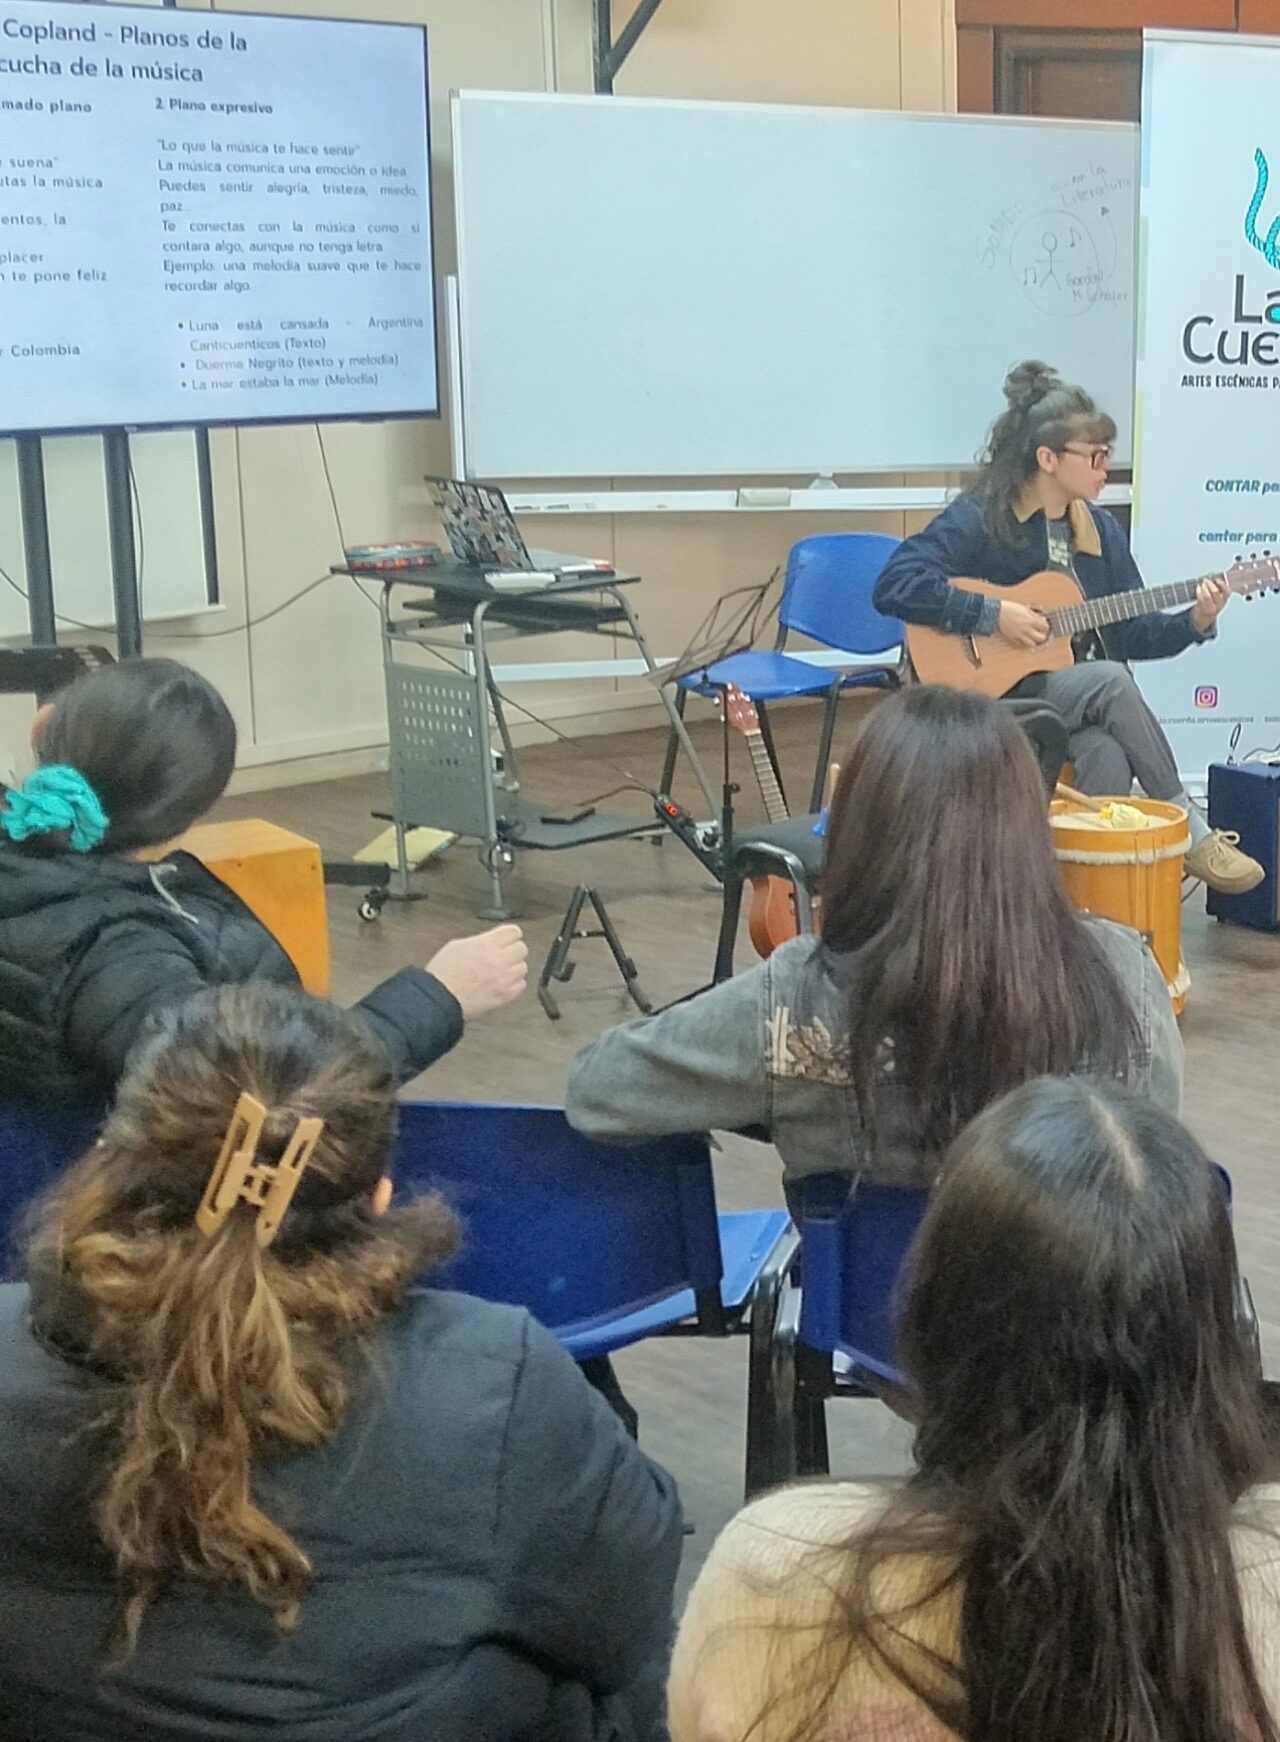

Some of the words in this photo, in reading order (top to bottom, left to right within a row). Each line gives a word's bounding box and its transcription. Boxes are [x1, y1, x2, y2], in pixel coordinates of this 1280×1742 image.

[3, 18, 96, 44] Copland
[121, 25, 190, 48] Planos
[197, 30, 223, 50] de
[231, 31, 248, 51] la
[70, 56, 97, 77] de
[105, 58, 124, 78] la
[132, 61, 203, 82] música
[49, 99, 92, 115] plano
[169, 97, 206, 111] Plano
[210, 101, 273, 115] expresivo
[182, 141, 206, 154] que
[211, 139, 222, 152] la
[226, 142, 269, 154] música
[273, 143, 286, 154] te
[290, 141, 319, 155] hace
[158, 159, 173, 171] La
[178, 160, 222, 172] música
[226, 162, 285, 174] comunica
[289, 165, 311, 175] una
[315, 164, 365, 176] emoción
[369, 167, 378, 176] o
[33, 174, 46, 187] la
[53, 176, 103, 188] música
[159, 179, 206, 192] Puedes
[219, 181, 253, 193] sentir
[53, 212, 67, 225] la
[162, 219, 176, 232] Te
[189, 221, 245, 232] conectas
[258, 223, 280, 232] con
[293, 220, 303, 232] la
[315, 221, 356, 233] música
[367, 223, 399, 233] como
[411, 223, 420, 233] si
[162, 240, 210, 252] contara
[249, 242, 295, 254] aunque
[299, 242, 315, 252] no
[319, 242, 353, 254] tenga
[223, 261, 246, 271] una
[307, 262, 341, 271] suave
[347, 262, 370, 274] que
[376, 260, 388, 271] te
[394, 259, 421, 271] hace
[12, 271, 27, 282] te
[34, 272, 71, 284] pone
[77, 269, 107, 282] feliz
[164, 279, 217, 291] recordar
[189, 319, 219, 331] Luna
[237, 319, 263, 330] está
[280, 317, 329, 330] cansada
[368, 316, 424, 331] Argentina
[11, 344, 81, 357] Colombia
[190, 338, 281, 352] Canticuenticos
[285, 337, 326, 351] (Texto)
[196, 358, 244, 370] Duerme
[248, 357, 294, 371] Negrito
[298, 357, 333, 370] (texto
[338, 358, 344, 368] y
[192, 379, 207, 391] La
[211, 381, 234, 389] mar
[239, 376, 280, 389] estaba
[284, 376, 294, 387] la
[299, 377, 320, 387] mar
[1181, 374, 1212, 388] ARTES
[1215, 373, 1269, 389] ESCÉNICAS
[1205, 479, 1261, 493] CONTAR
[1198, 529, 1244, 543] cantar
[1245, 531, 1278, 545] para
